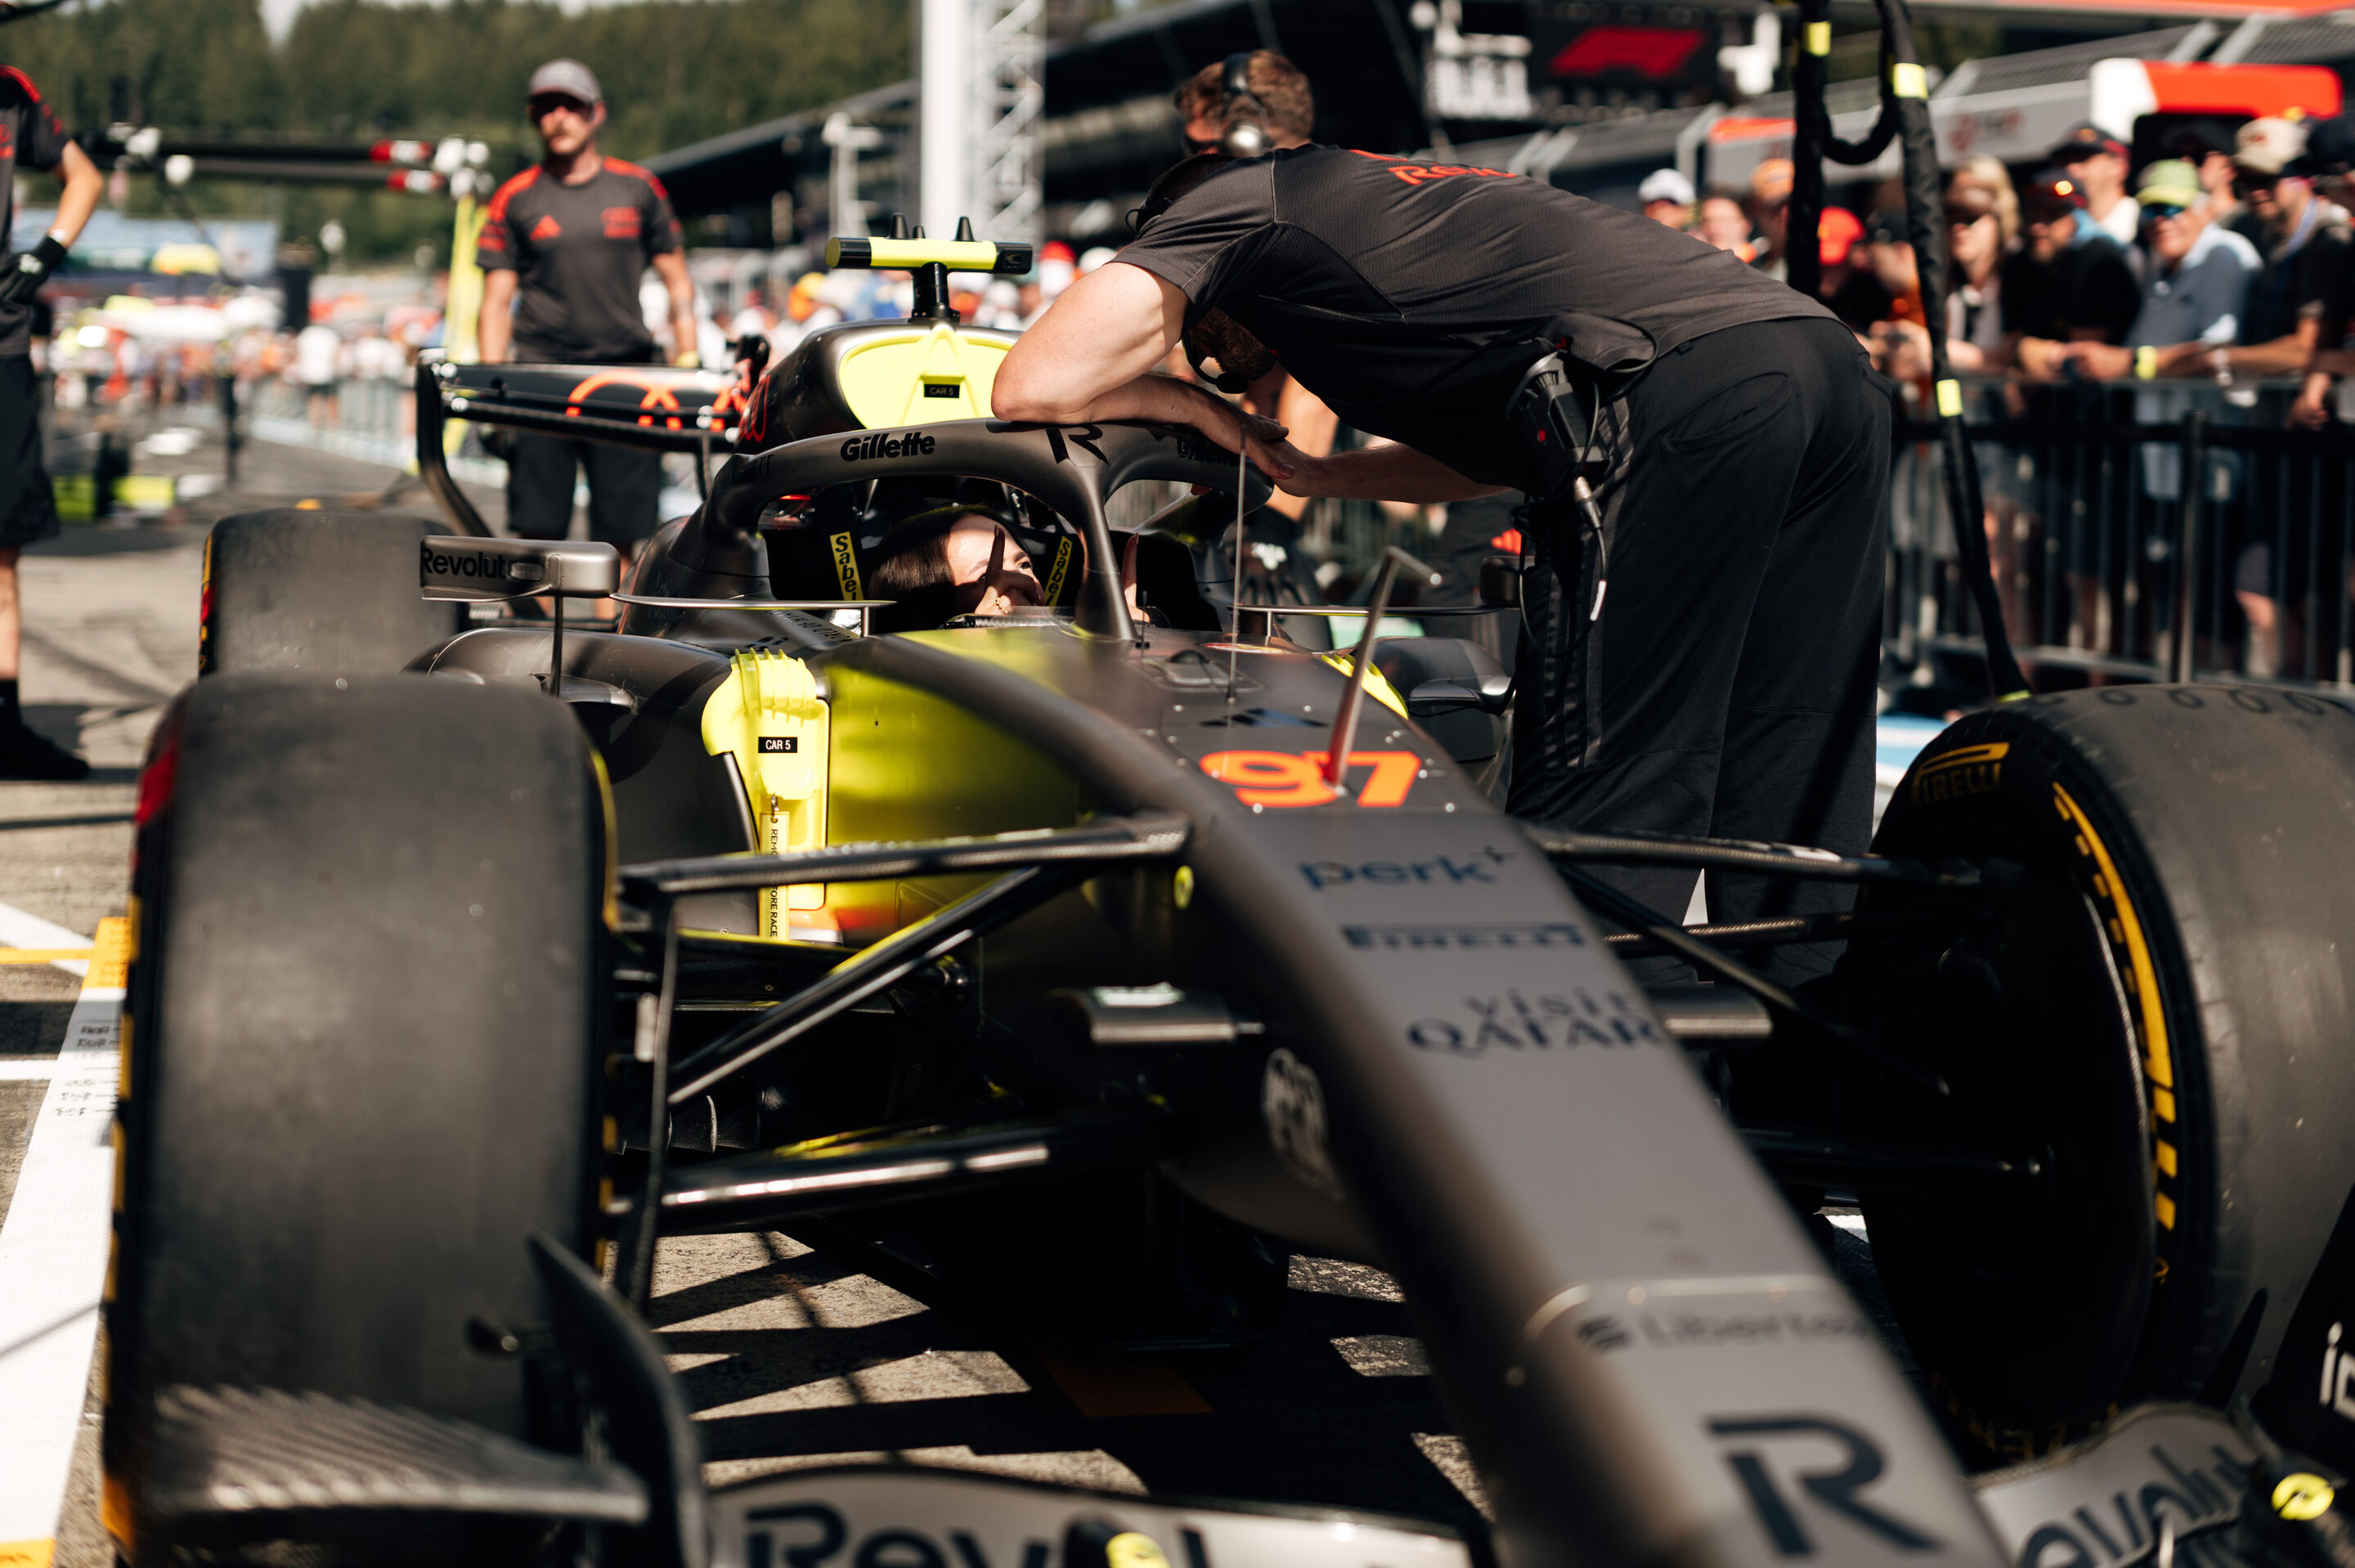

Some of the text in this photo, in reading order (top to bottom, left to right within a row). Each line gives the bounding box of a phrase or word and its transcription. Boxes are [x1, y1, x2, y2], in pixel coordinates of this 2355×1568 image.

[929, 387, 953, 396] CAR 5
[840, 431, 935, 463] Gillette
[421, 547, 508, 580] Revolut
[765, 739, 791, 750] CAR 5
[1706, 1414, 1942, 1558] R
